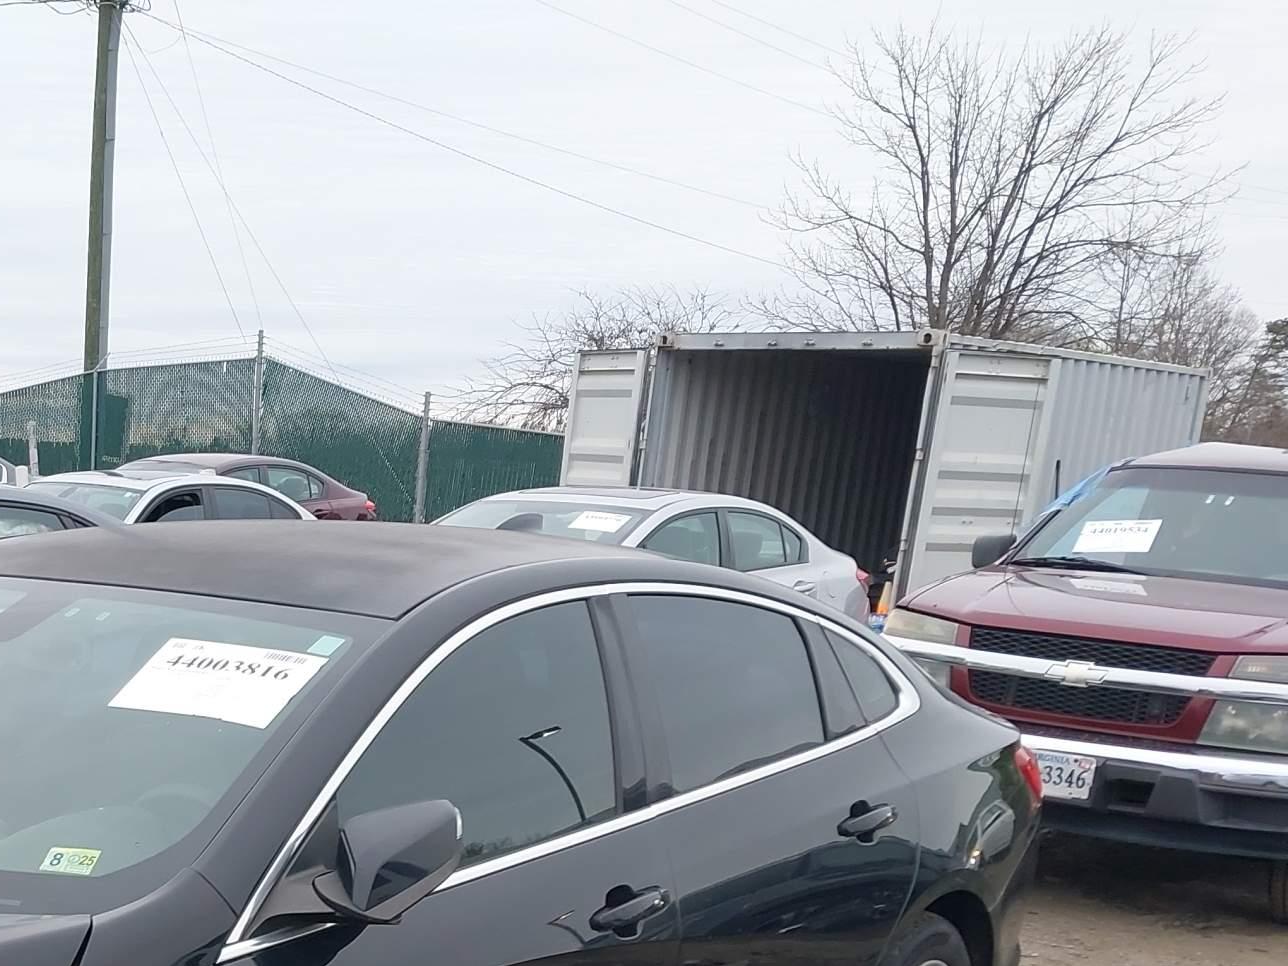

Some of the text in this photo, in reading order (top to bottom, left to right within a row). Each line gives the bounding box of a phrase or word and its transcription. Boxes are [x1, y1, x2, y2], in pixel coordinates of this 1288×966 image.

[165, 653, 291, 681] 44003816
[1042, 765, 1091, 789] 3346
[49, 852, 97, 867] 8 25
